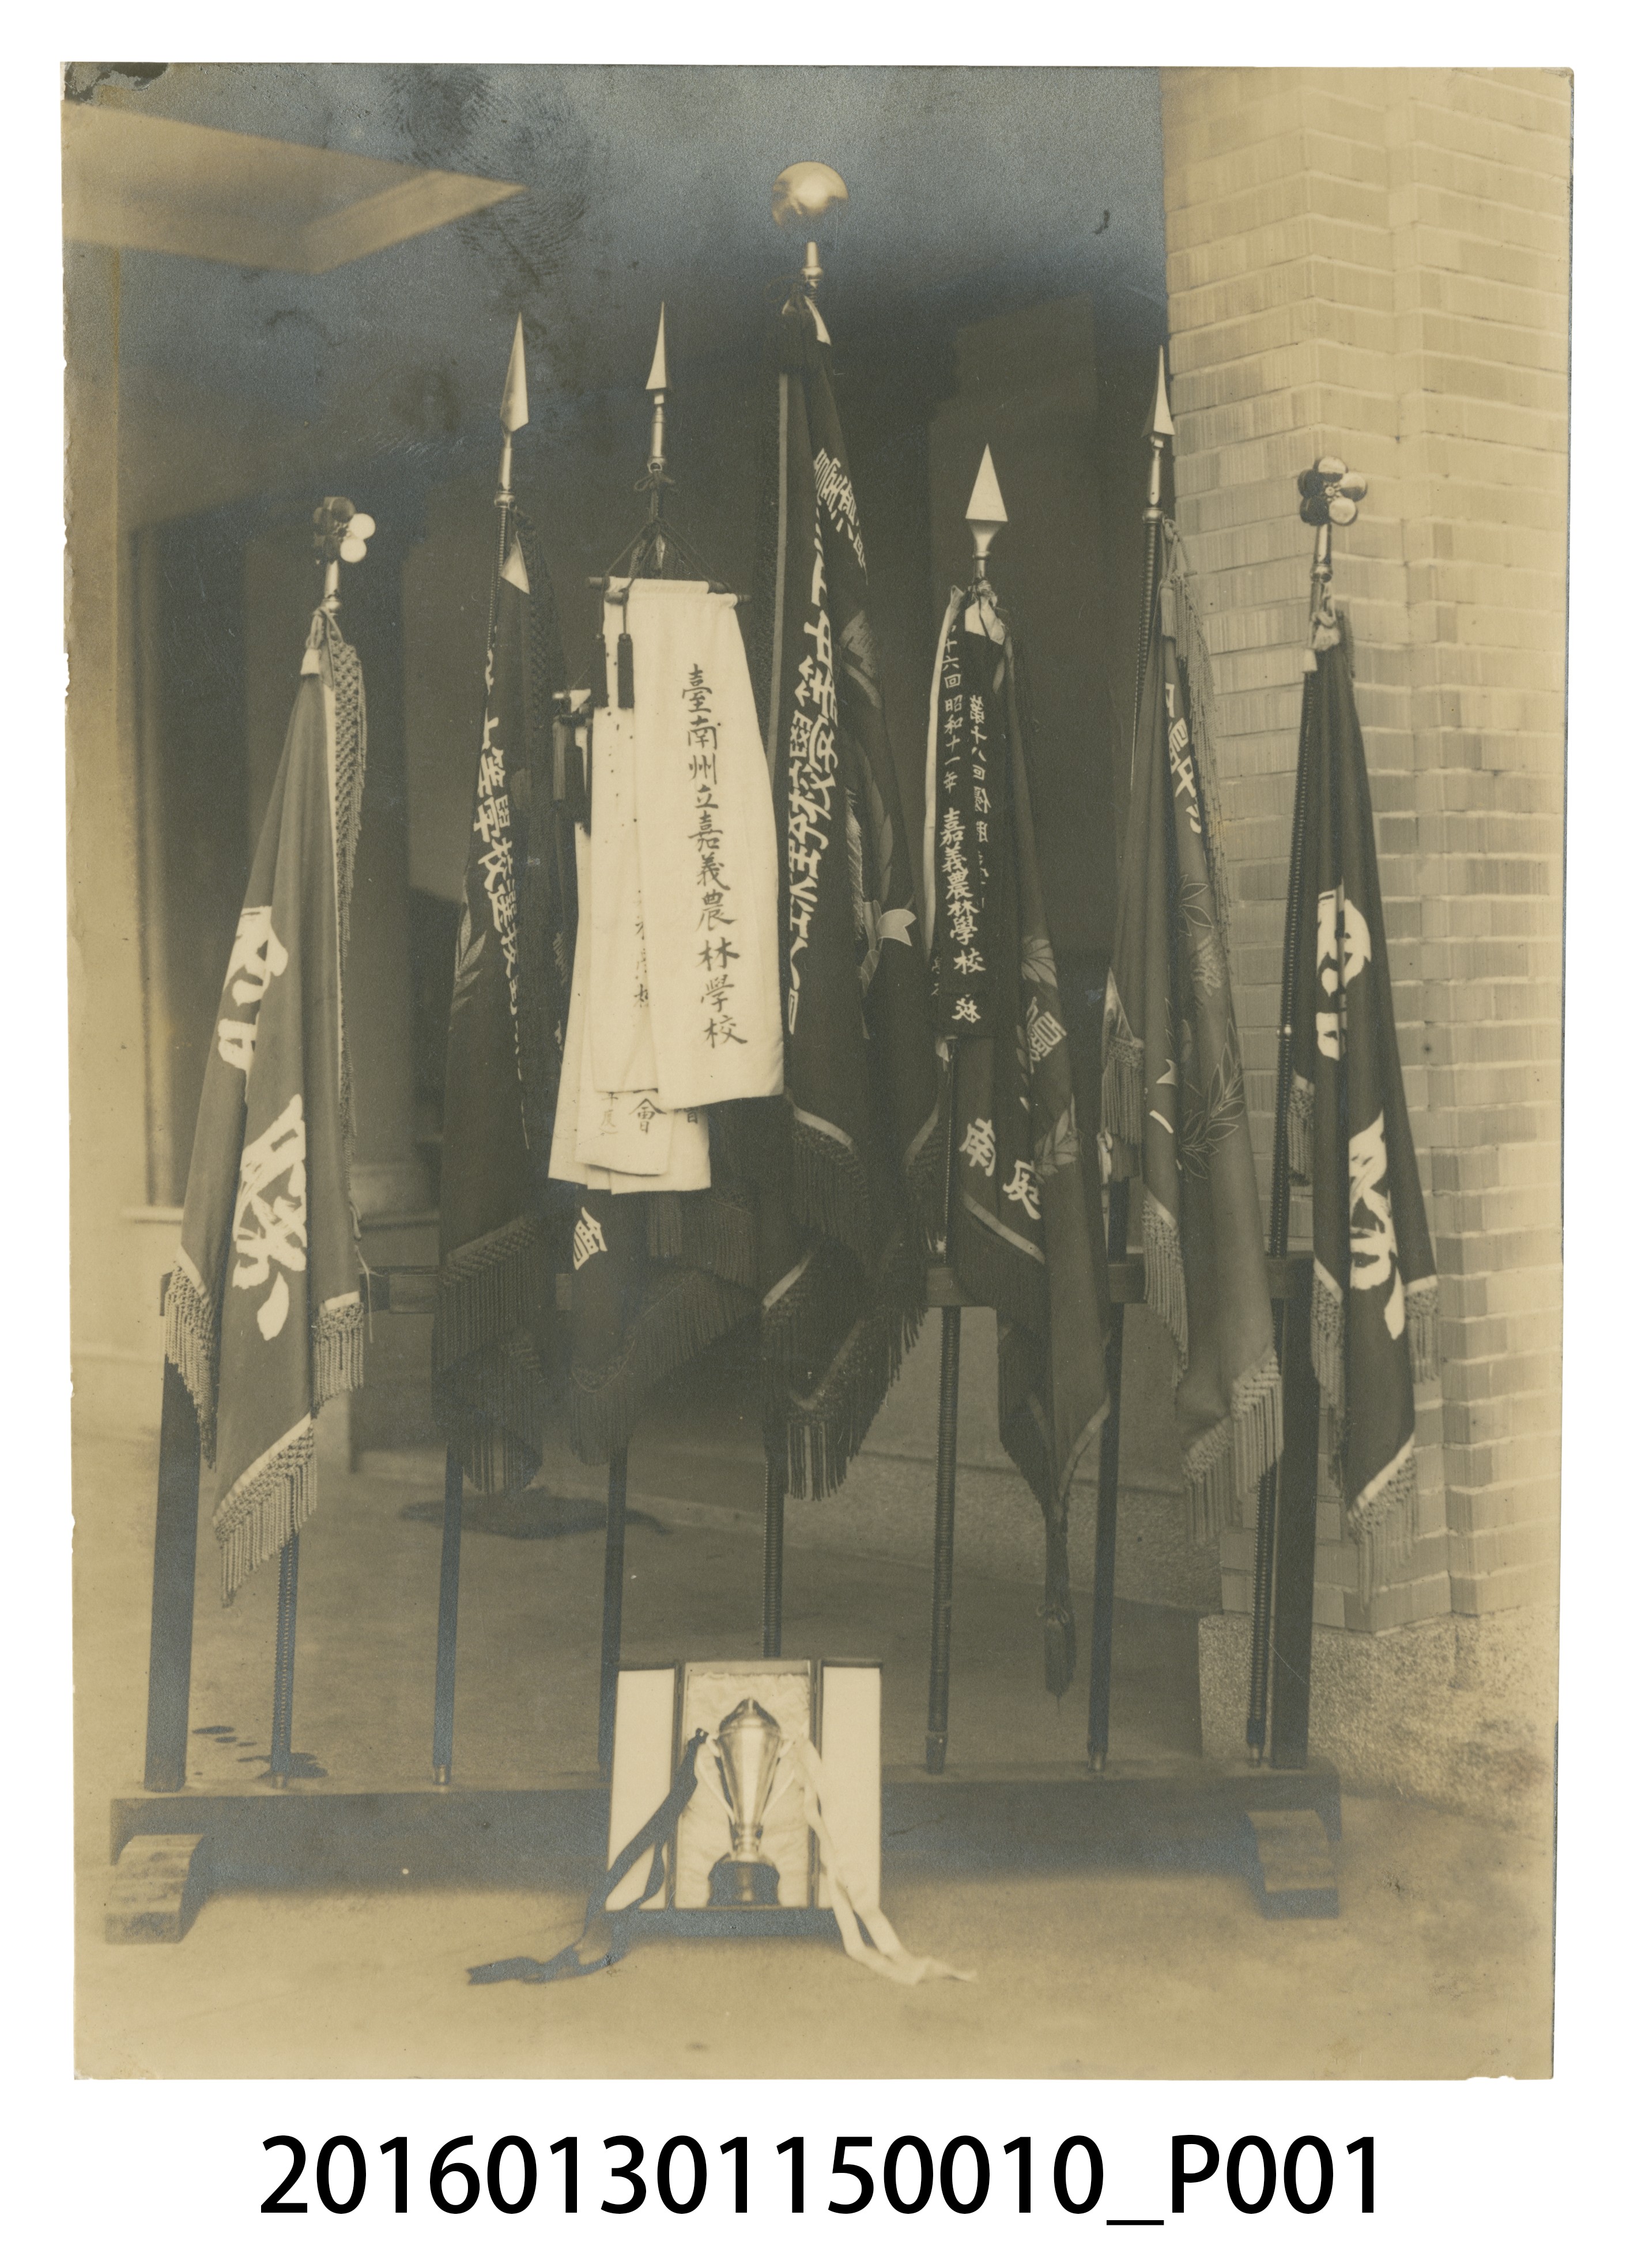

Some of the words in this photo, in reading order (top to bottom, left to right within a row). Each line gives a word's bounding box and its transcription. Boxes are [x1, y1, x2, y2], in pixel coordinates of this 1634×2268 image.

[682, 663, 748, 1049] 臺南州立嘉義農林學校
[628, 1098, 667, 1134] 會
